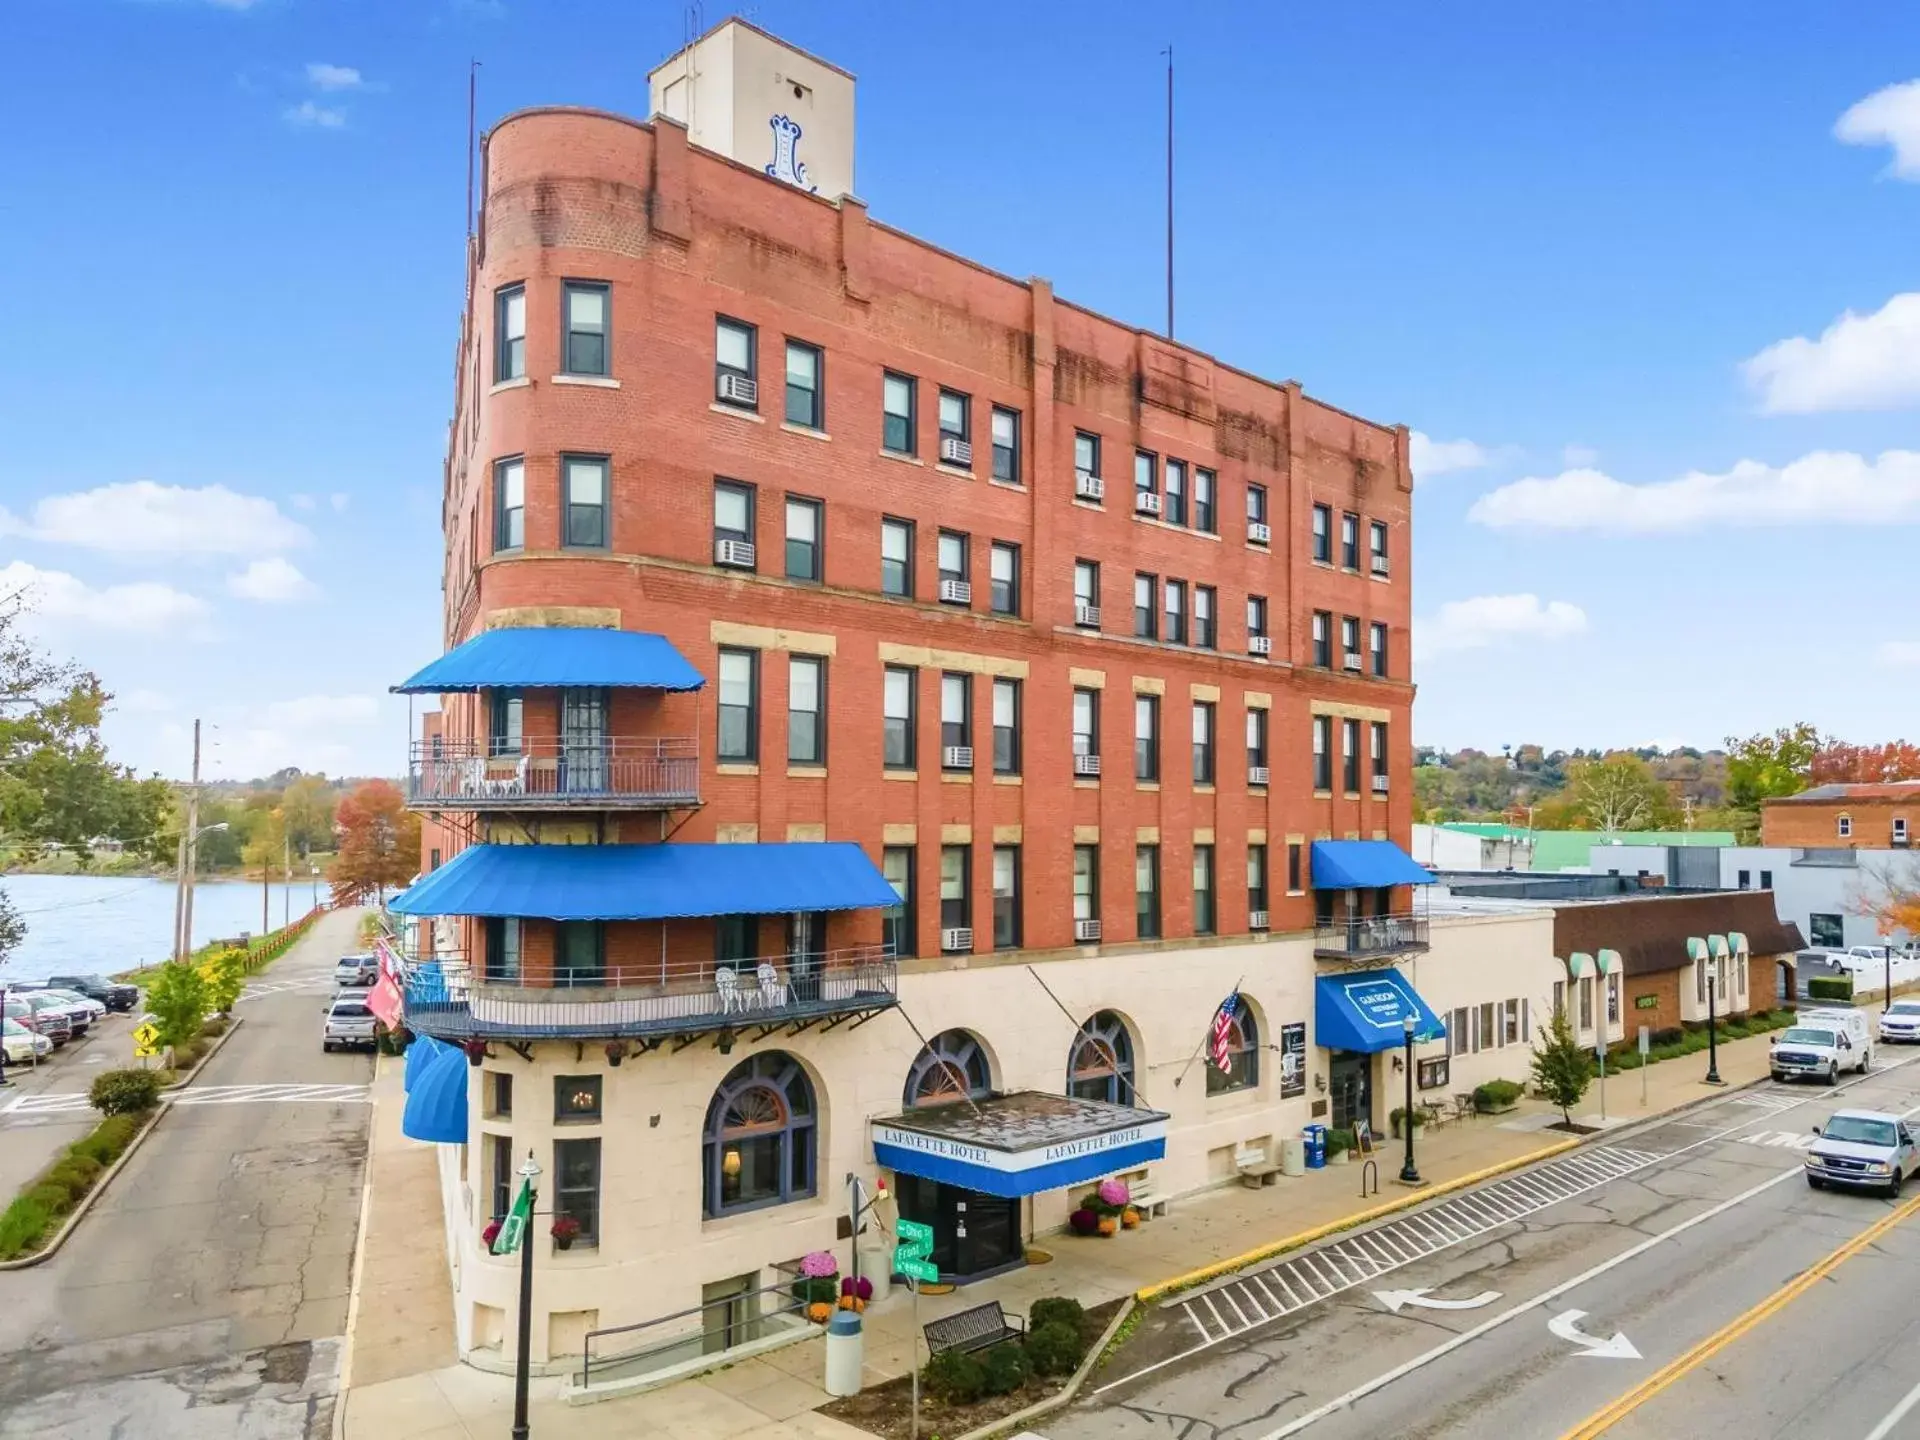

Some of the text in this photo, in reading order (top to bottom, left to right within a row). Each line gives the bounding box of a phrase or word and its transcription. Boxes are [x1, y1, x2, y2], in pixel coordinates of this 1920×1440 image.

[885, 1130, 991, 1163] LAFAYETTE HOTEL
[1046, 1127, 1143, 1160] LAFAYETTE HOTEL
[898, 1244, 919, 1260] Front
